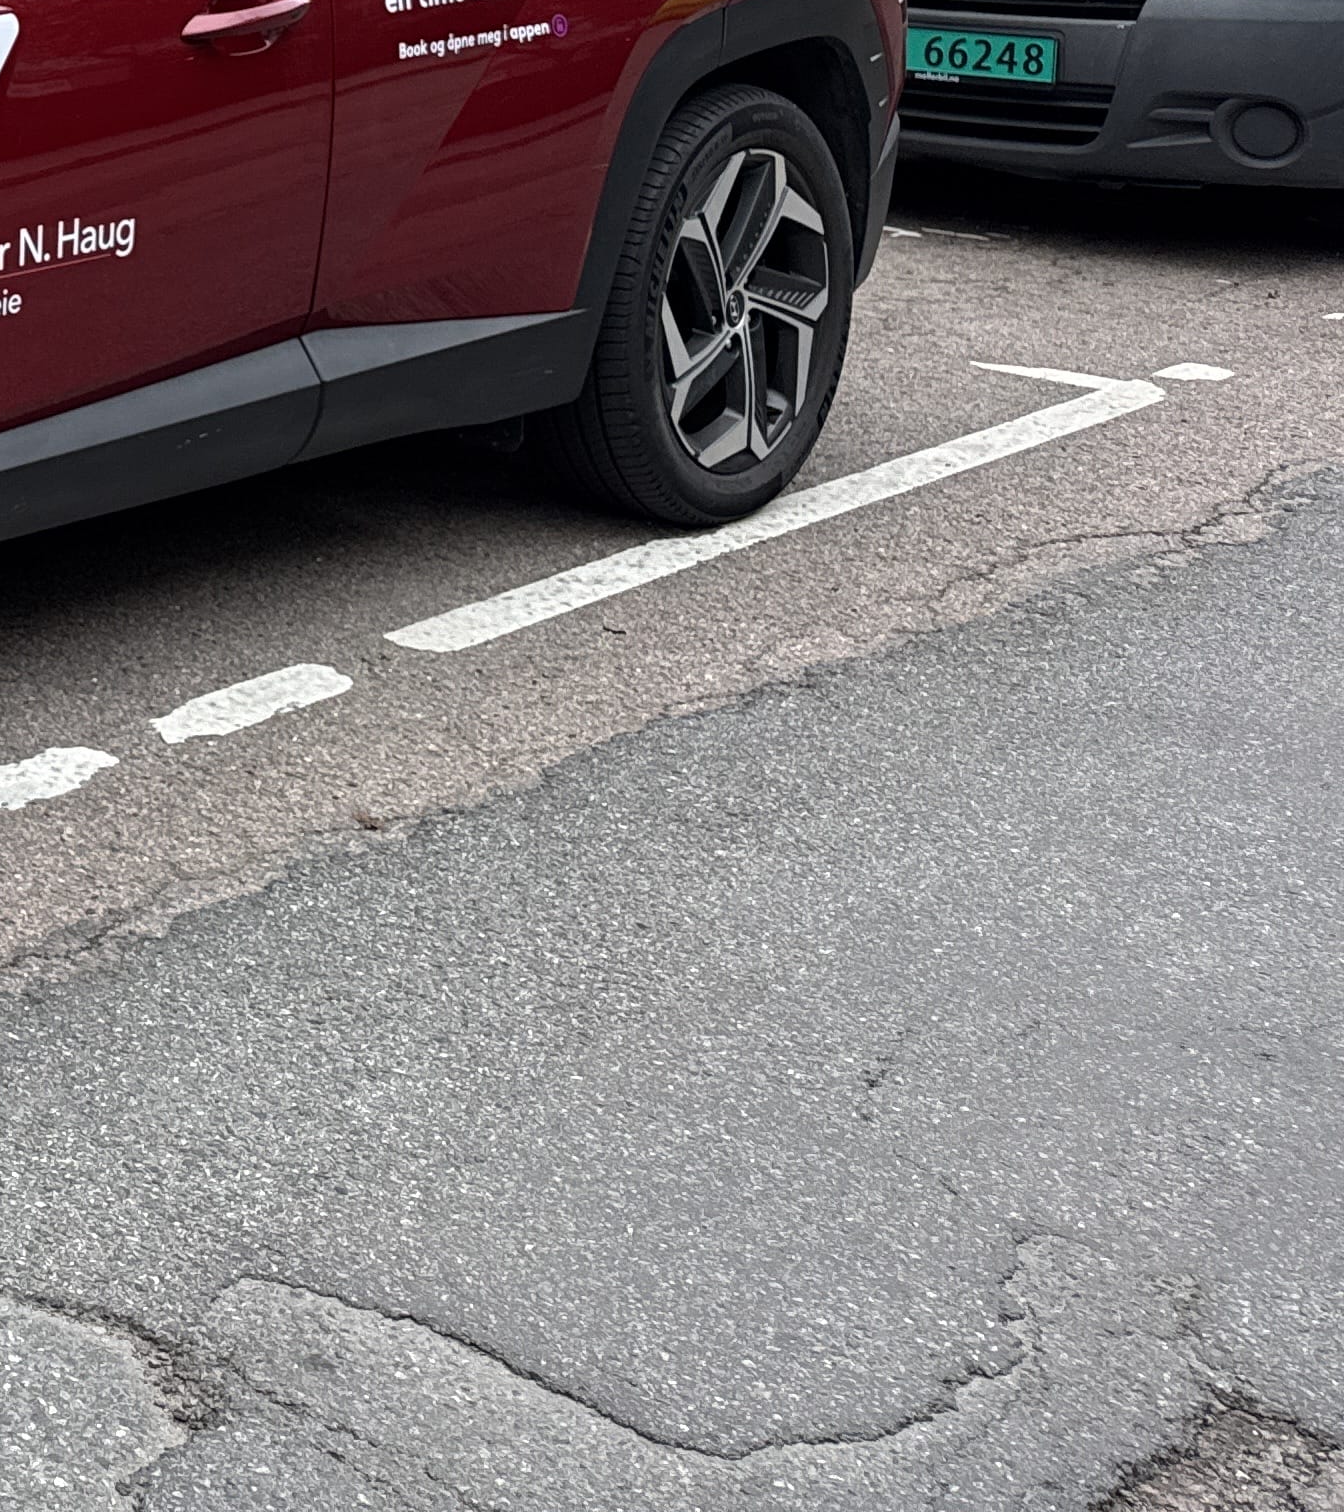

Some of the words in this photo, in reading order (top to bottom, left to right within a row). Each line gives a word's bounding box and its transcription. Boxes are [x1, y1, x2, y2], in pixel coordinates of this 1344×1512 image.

[398, 39, 428, 59] Book
[430, 41, 446, 57] og
[447, 33, 475, 54] åpne
[477, 30, 502, 47] meg
[503, 24, 509, 40] i
[510, 22, 550, 43] appen
[924, 36, 1044, 75] 66248
[19, 224, 51, 267] N.
[57, 218, 136, 257] Haug
